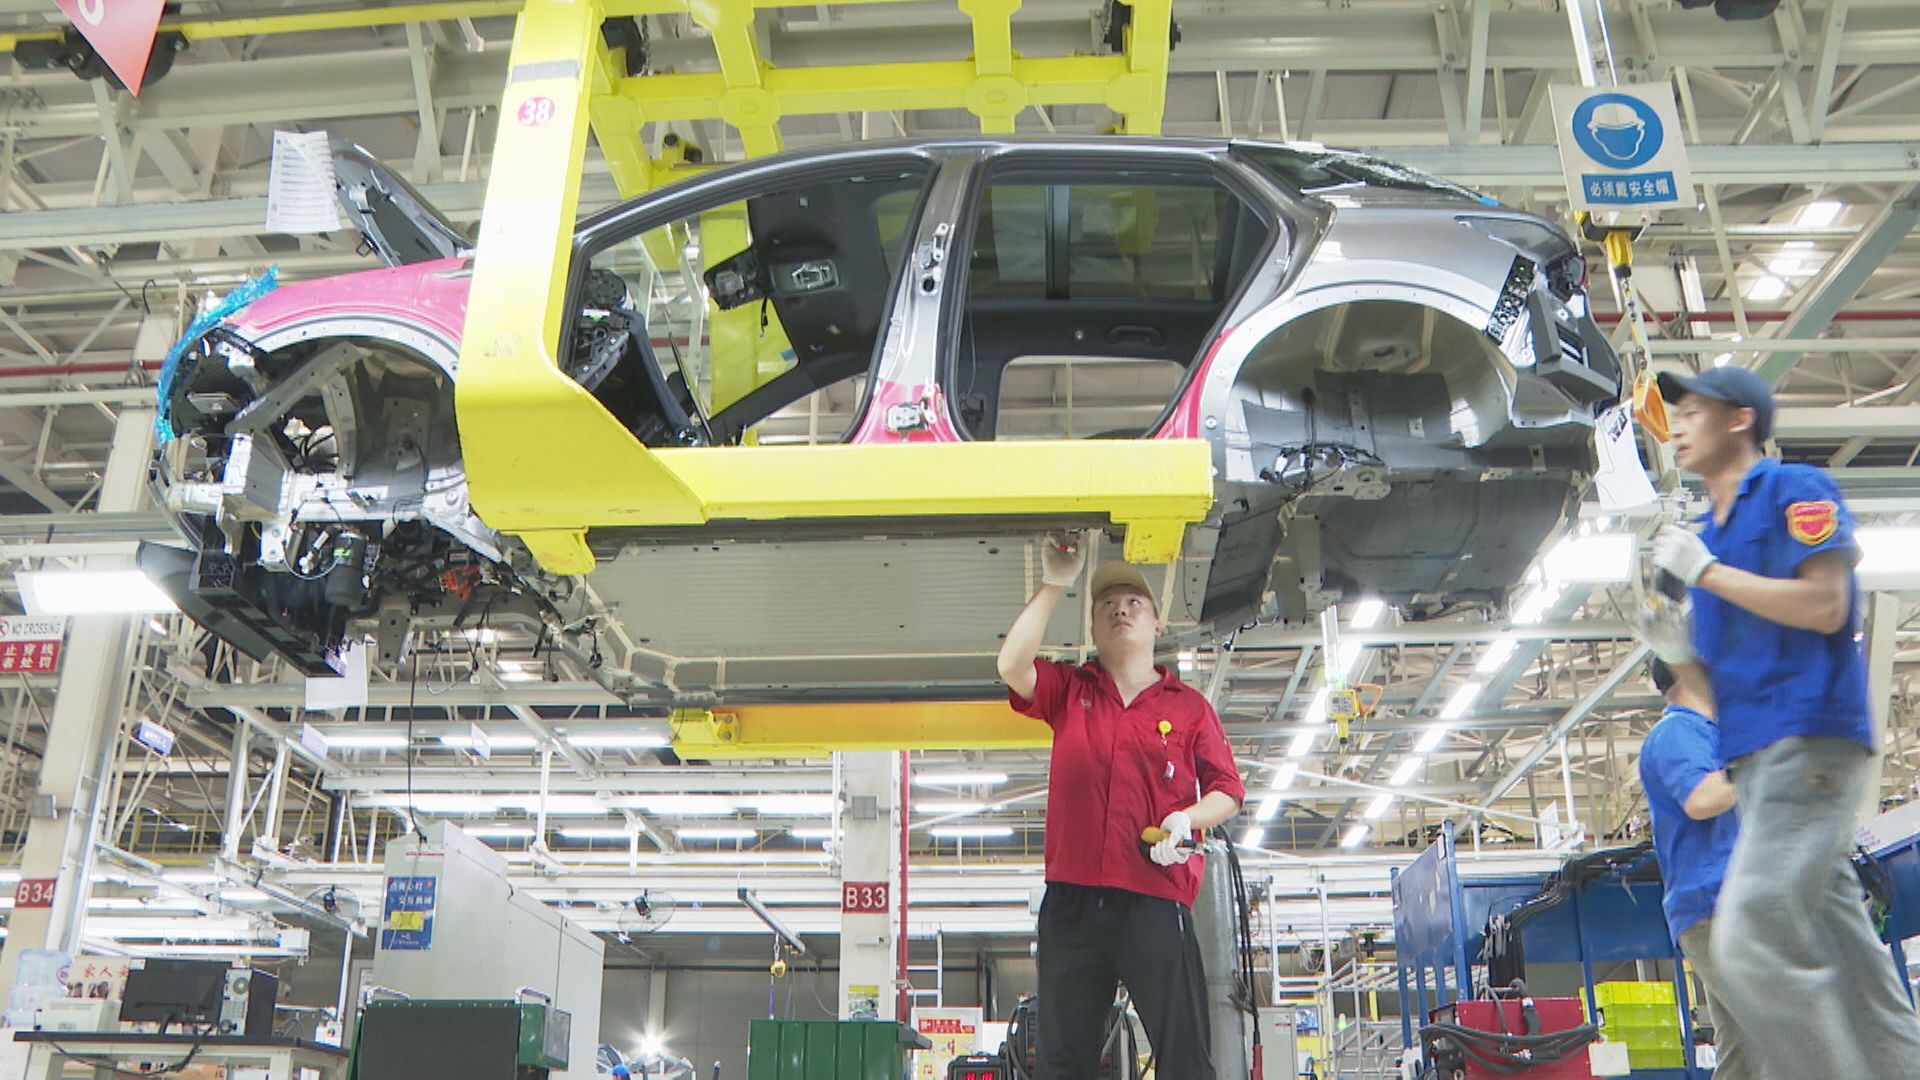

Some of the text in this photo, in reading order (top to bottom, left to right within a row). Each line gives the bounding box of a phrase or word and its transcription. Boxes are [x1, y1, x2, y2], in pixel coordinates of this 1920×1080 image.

[522, 100, 551, 124] 38
[1590, 177, 1670, 198] 必须戴安全帽
[13, 621, 61, 635] NO CROSSING
[18, 882, 54, 904] B34
[846, 886, 886, 909] B33
